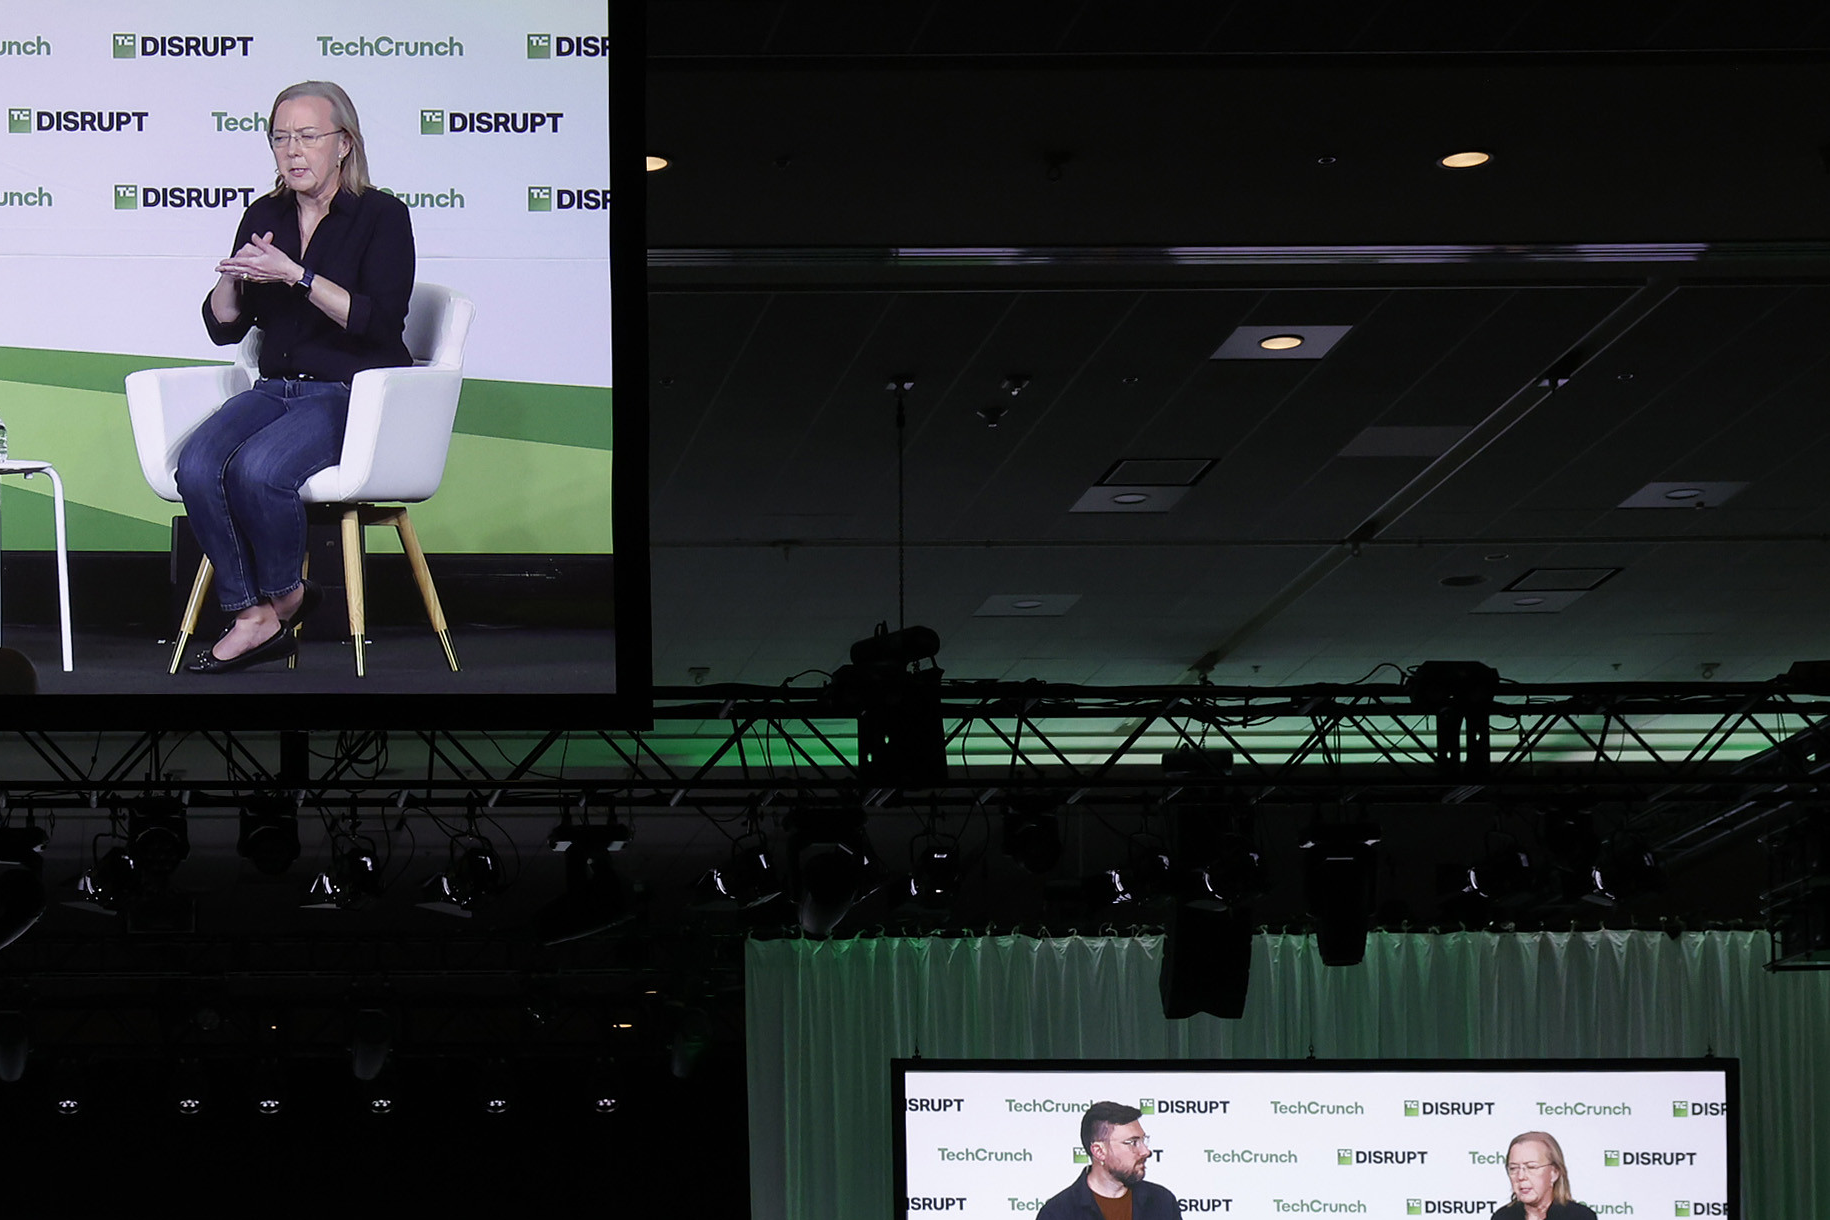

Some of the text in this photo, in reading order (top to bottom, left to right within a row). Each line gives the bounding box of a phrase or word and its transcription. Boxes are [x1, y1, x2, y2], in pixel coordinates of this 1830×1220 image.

[115, 35, 254, 57] TC DISRUPT
[316, 36, 464, 57] TechCrunch
[530, 36, 549, 47] TC
[10, 110, 149, 132] TC DISRUPT
[423, 112, 564, 133] TC DISRUPT
[116, 186, 255, 208] TC DISRUPT
[531, 189, 550, 199] TC
[1158, 1100, 1230, 1114] DISRUPT
[1270, 1101, 1365, 1115] TechCrunch
[1422, 1102, 1495, 1115] DISRUPT
[1536, 1102, 1632, 1115] TechCrunch
[938, 1147, 1033, 1161] TechCrunch
[1204, 1149, 1299, 1163] TechCrunch
[1355, 1151, 1428, 1165] DISRUPT
[1623, 1152, 1697, 1166] DISRUPT
[907, 1197, 967, 1211] ISRUPT
[1178, 1198, 1233, 1212] SRUPT
[1273, 1199, 1368, 1213] TechCrunch
[1425, 1200, 1497, 1214] DISRUPT
